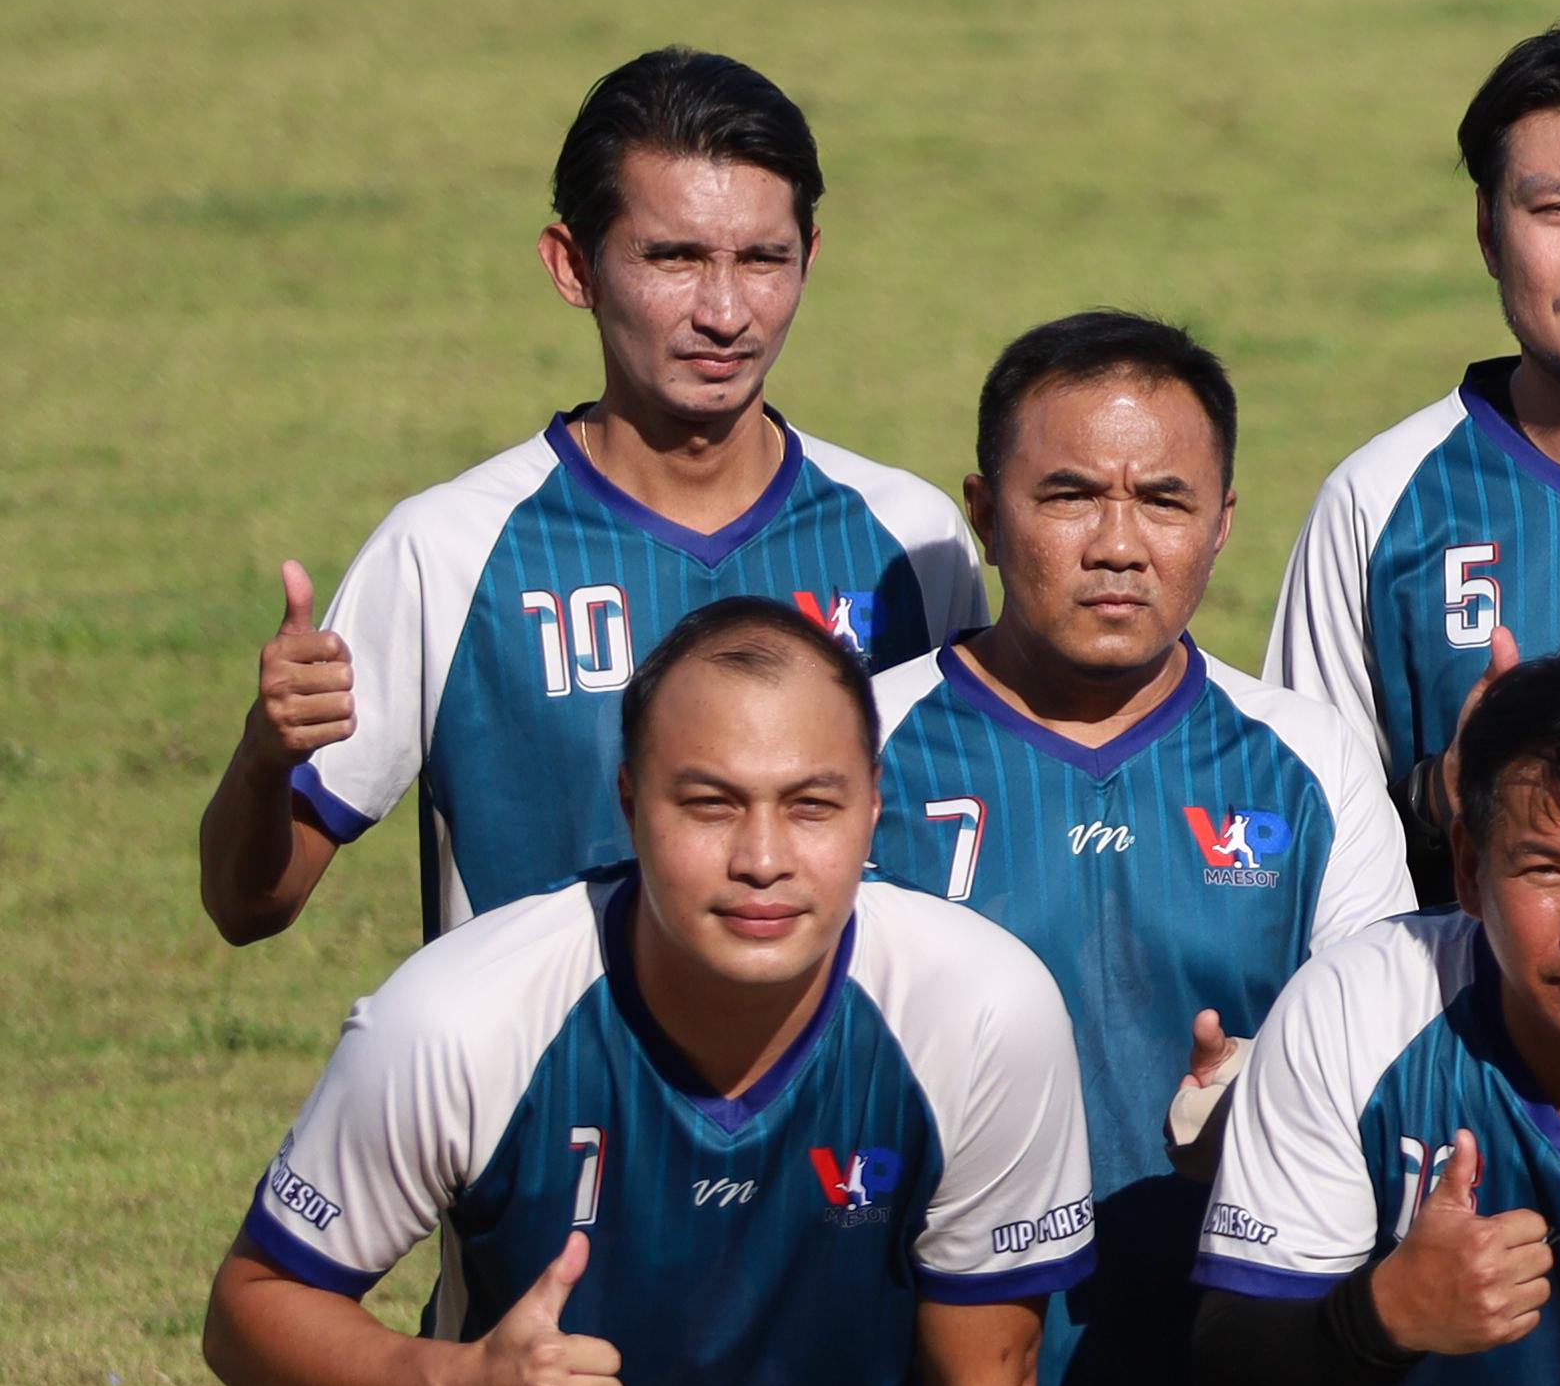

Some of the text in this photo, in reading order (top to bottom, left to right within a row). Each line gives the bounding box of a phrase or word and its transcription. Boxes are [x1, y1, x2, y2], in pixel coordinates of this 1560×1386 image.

[521, 584, 634, 697] 10
[1443, 542, 1501, 649] 5
[924, 795, 987, 901] 7
[1203, 868, 1280, 889] MAESOT
[992, 1220, 1036, 1254] VIP
